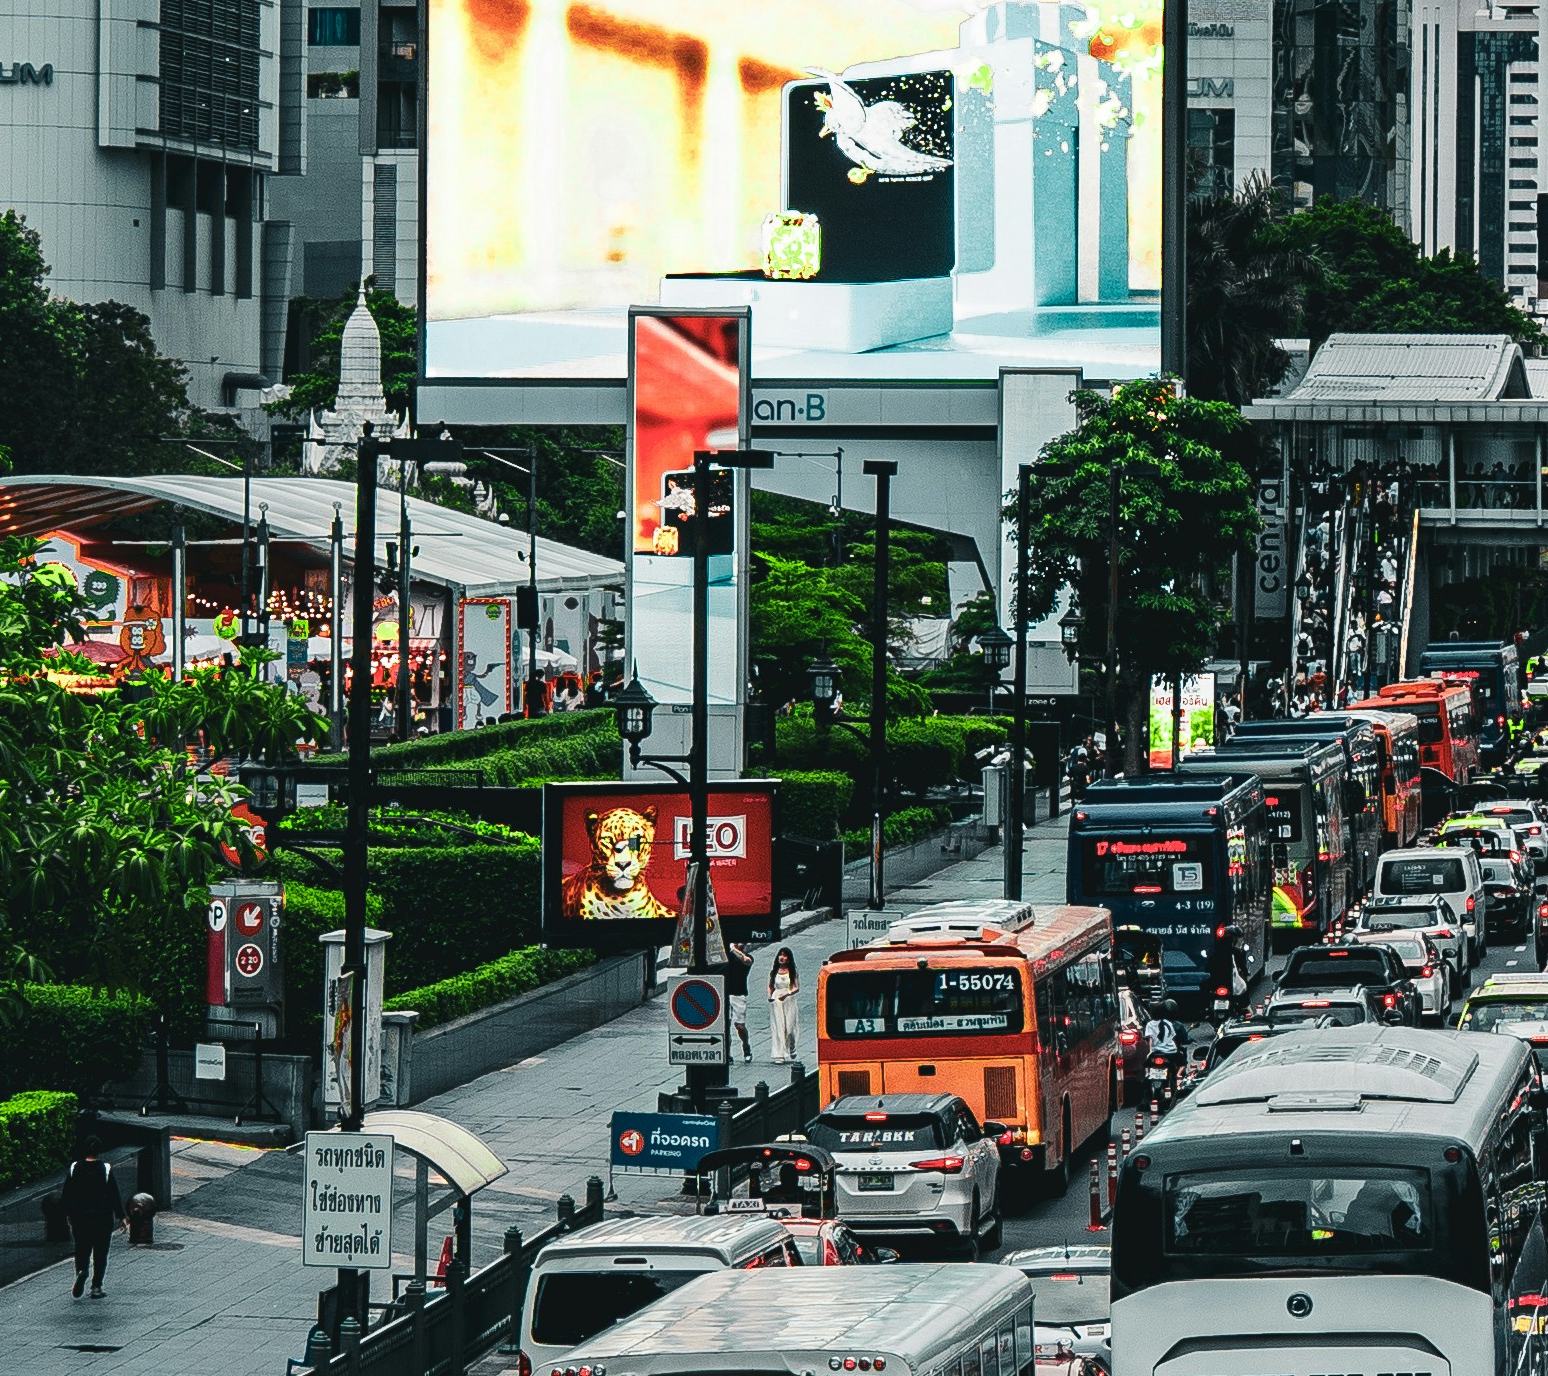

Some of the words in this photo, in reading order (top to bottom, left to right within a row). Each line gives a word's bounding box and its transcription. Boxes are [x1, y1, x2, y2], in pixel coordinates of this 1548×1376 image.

[939, 974, 1014, 991] 1-55074
[854, 1020, 877, 1033] A3
[672, 1049, 722, 1061] ตลอดเวลา
[651, 1127, 710, 1148] ที่จอดรถ
[315, 1144, 385, 1174] รถทุกชนิด
[311, 1180, 381, 1214] ใช้ช่องทาง
[732, 1200, 759, 1209] TAXI
[314, 1223, 383, 1261] ซ้ายสุดได้
